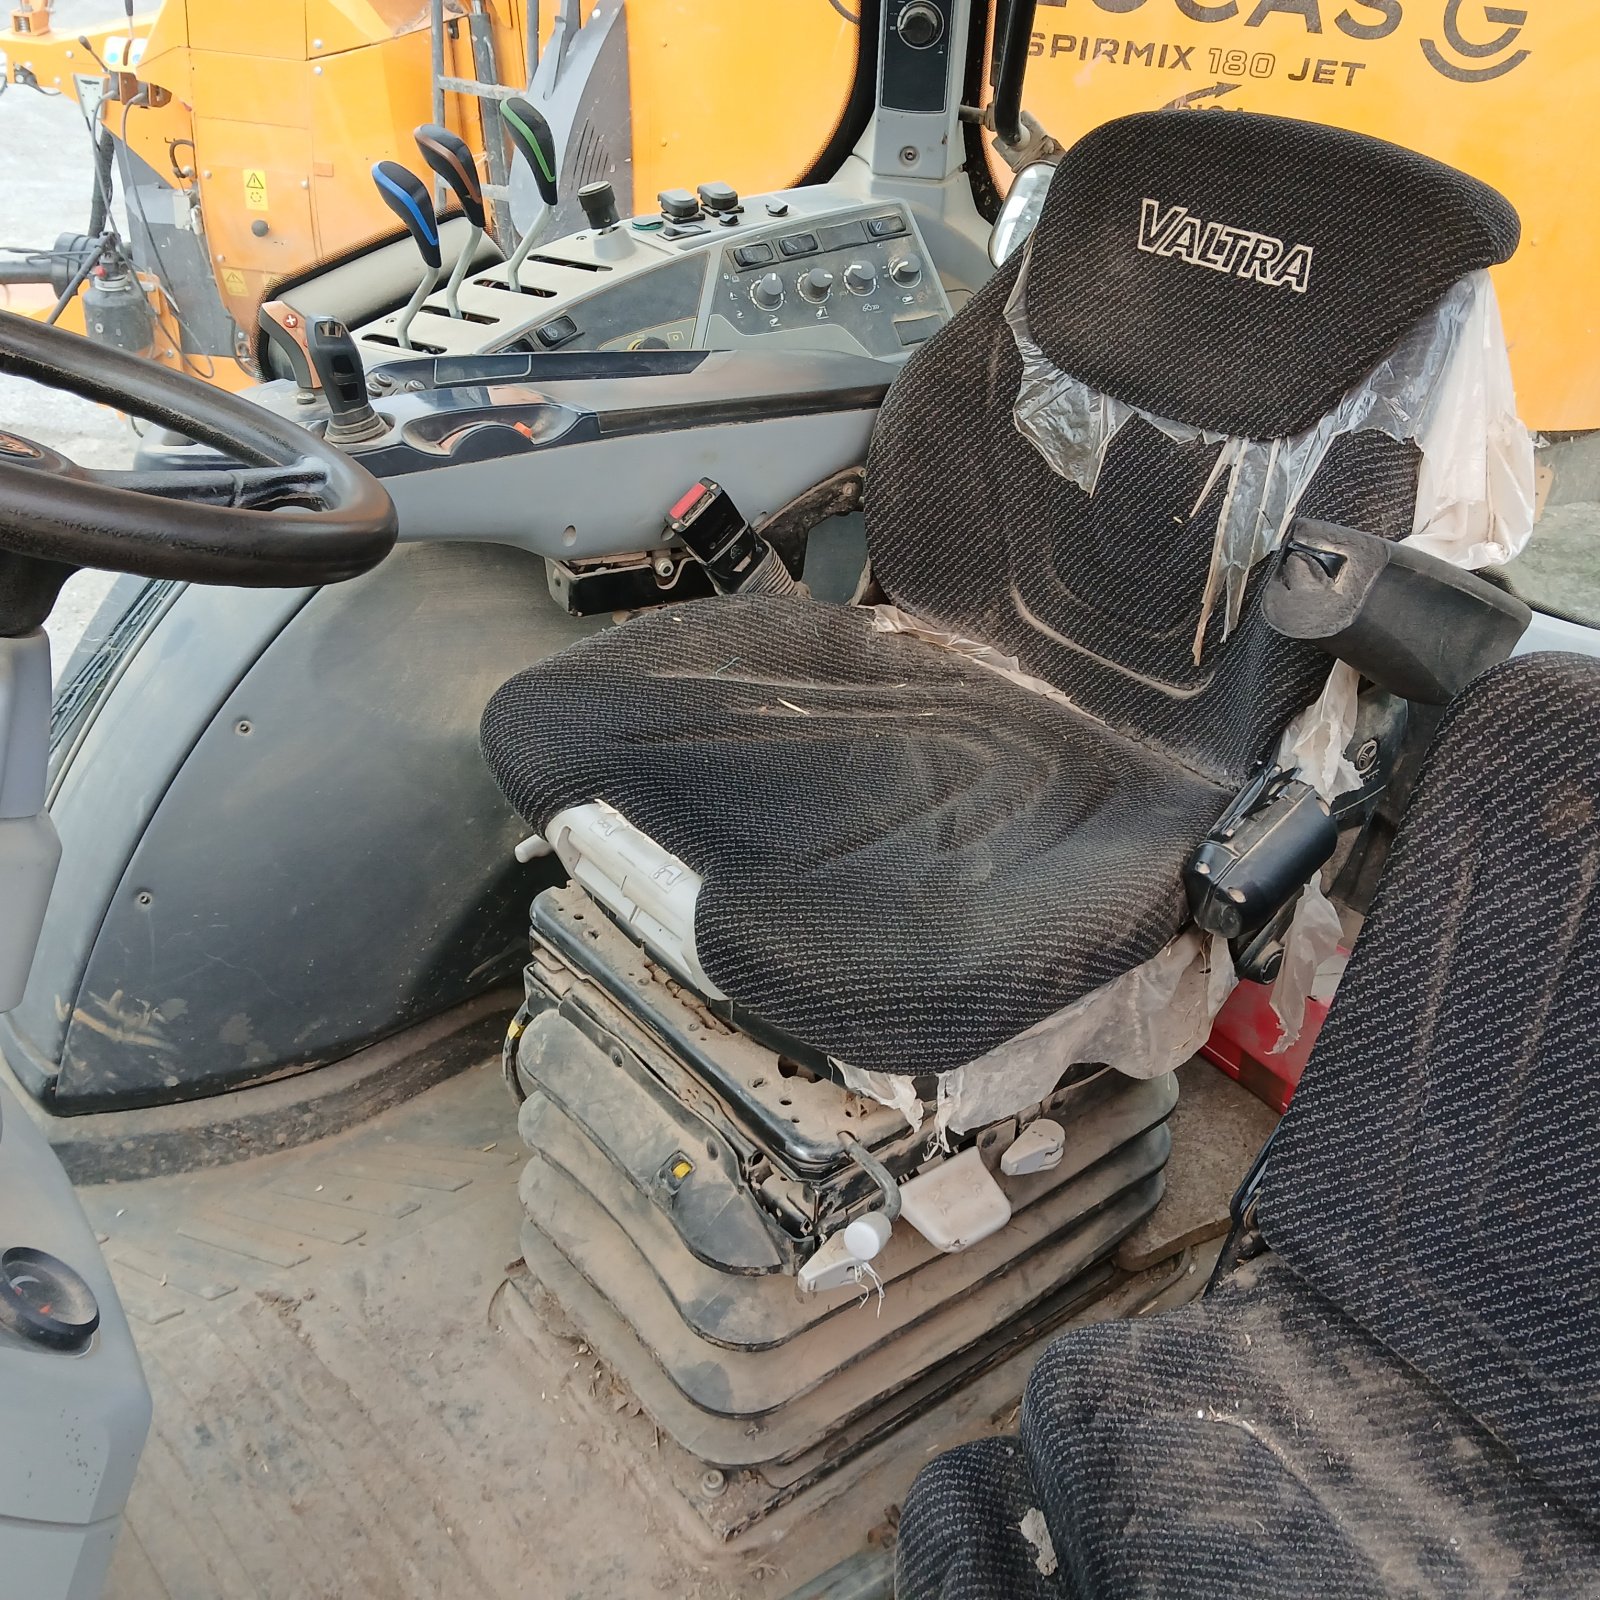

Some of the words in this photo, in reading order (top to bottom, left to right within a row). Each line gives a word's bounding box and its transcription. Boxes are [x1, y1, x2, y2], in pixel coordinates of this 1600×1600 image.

[1208, 48, 1276, 79] 180
[1287, 57, 1367, 87] JET
[1137, 197, 1314, 294] VALTRA
